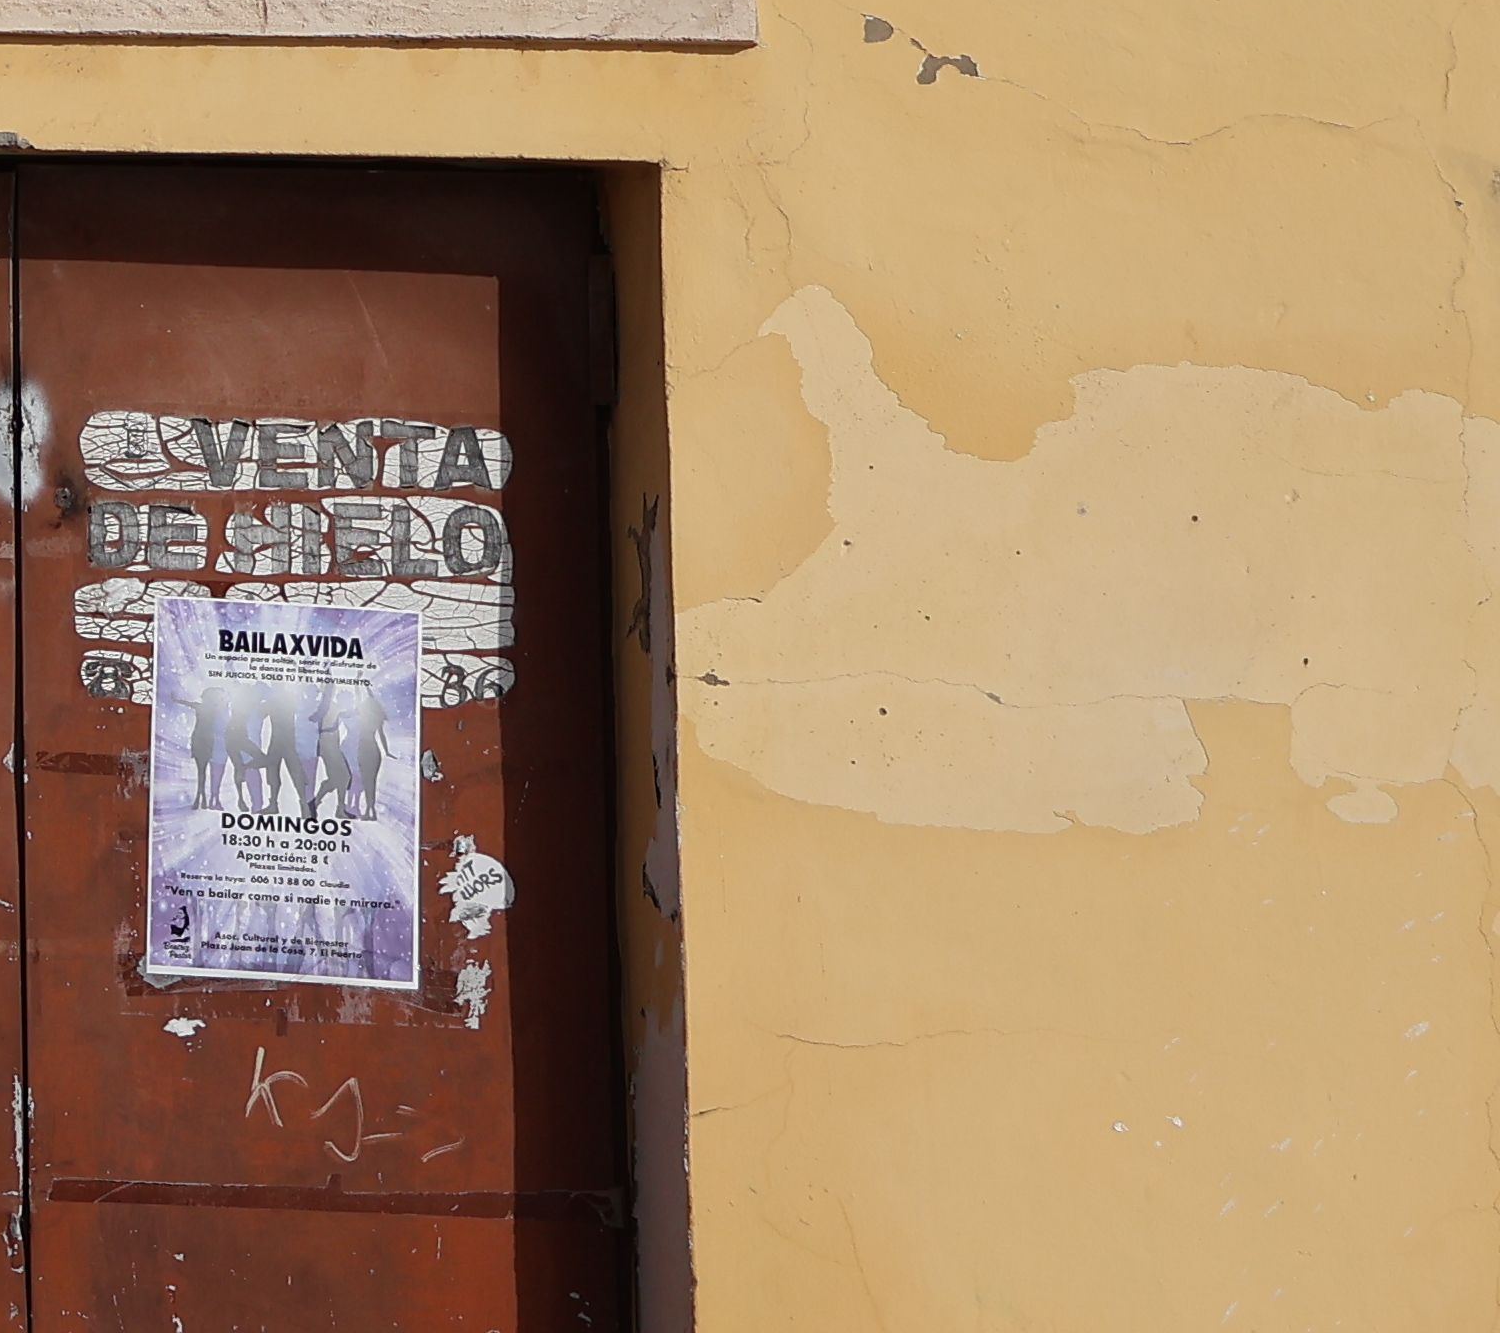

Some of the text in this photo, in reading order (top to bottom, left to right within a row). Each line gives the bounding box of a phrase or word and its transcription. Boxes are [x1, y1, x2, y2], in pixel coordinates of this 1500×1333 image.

[190, 416, 492, 491] VENTA
[88, 501, 503, 577] DE HIELO
[218, 629, 364, 660] BAILAXVIDA
[259, 664, 284, 672] danza
[330, 660, 365, 669] disfrutar
[366, 662, 377, 670] de
[208, 670, 223, 678] SIN
[225, 671, 259, 680] JUICIOS,
[261, 673, 283, 681] SOLO
[316, 677, 373, 687] MOVIMIENTO.
[221, 812, 353, 837] DOMINGOS
[221, 833, 350, 853] 18:30 h a 20:00 h
[236, 849, 307, 863] Aportación:
[310, 854, 319, 864] 8
[249, 862, 317, 873] Plazas limitadas.
[180, 872, 213, 881] Reserva
[250, 875, 269, 884] 606
[273, 876, 284, 885] 13
[287, 877, 299, 886] 88
[302, 878, 315, 887] 00
[319, 880, 350, 889] Claudia
[165, 884, 194, 898] "Ven
[208, 888, 244, 900] bailar
[248, 893, 280, 902] como
[284, 893, 293, 903] si
[297, 895, 331, 907] nadie
[335, 896, 347, 907] te
[350, 897, 400, 910] mirara."
[214, 931, 349, 948] Asoc. Cultural y de Bienestar
[200, 941, 227, 950] Plaza
[230, 942, 253, 951] Juan
[255, 944, 267, 953] de
[269, 945, 279, 954] la
[320, 949, 329, 957] El
[330, 949, 362, 959] Puerto
